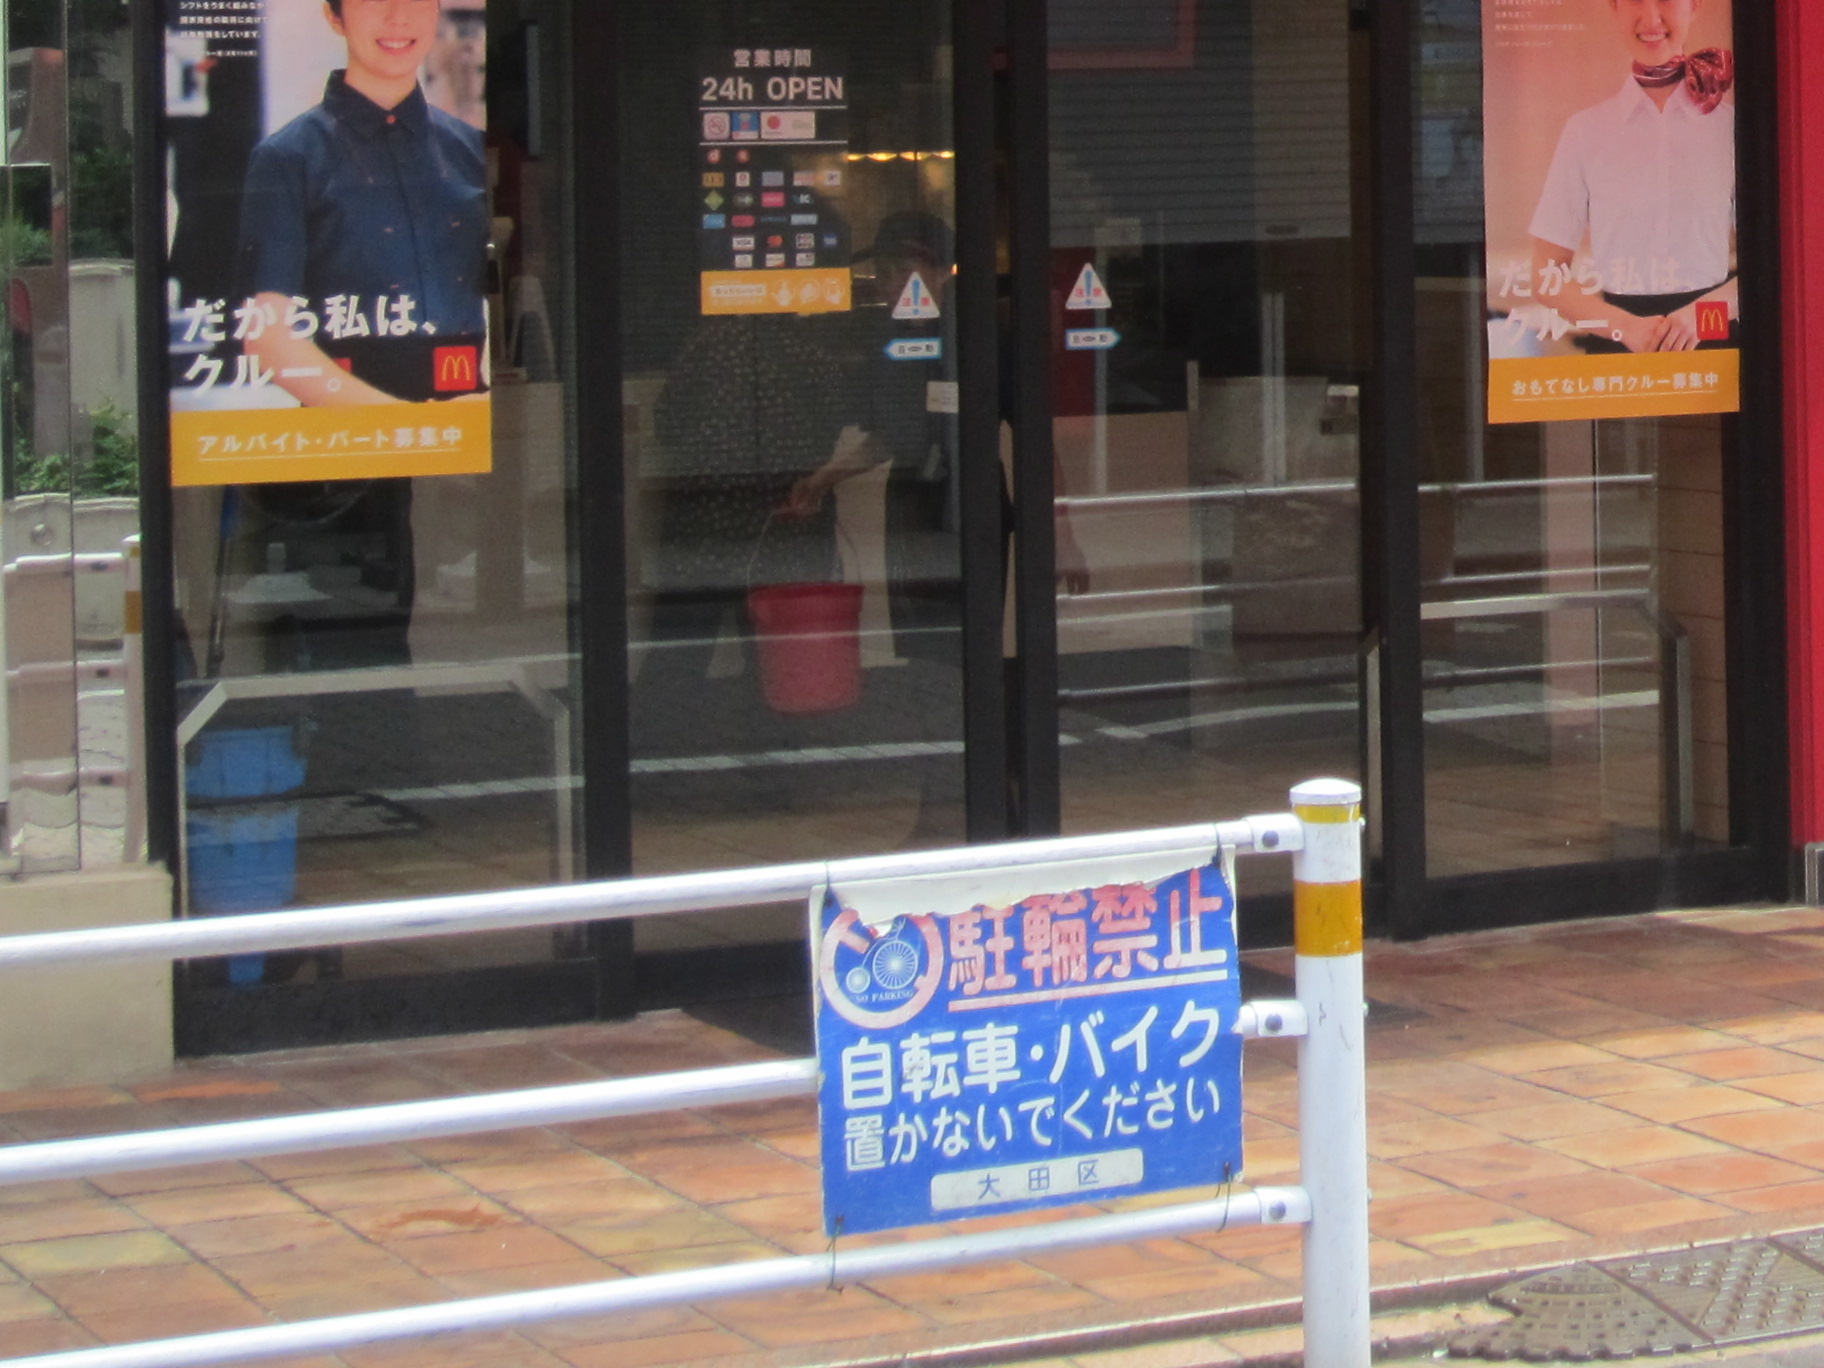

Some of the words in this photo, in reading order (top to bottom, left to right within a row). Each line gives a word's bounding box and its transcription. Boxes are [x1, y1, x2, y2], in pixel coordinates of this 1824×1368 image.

[734, 49, 812, 68] 営業時間
[702, 77, 753, 101] 24h
[767, 77, 843, 101] OPEN
[185, 294, 436, 342] だから私は、
[1502, 308, 1623, 346] クルー。
[185, 353, 341, 396] クルー。
[1512, 372, 1718, 395] おもてなし専門クルー募集中
[198, 426, 463, 455] アルバイト・パート募集中
[948, 869, 1228, 995] 駐輪禁止
[841, 1000, 1220, 1110] 自転車・バイク
[844, 1077, 1221, 1172] 置かないでください
[978, 1159, 1100, 1200] 大田区
